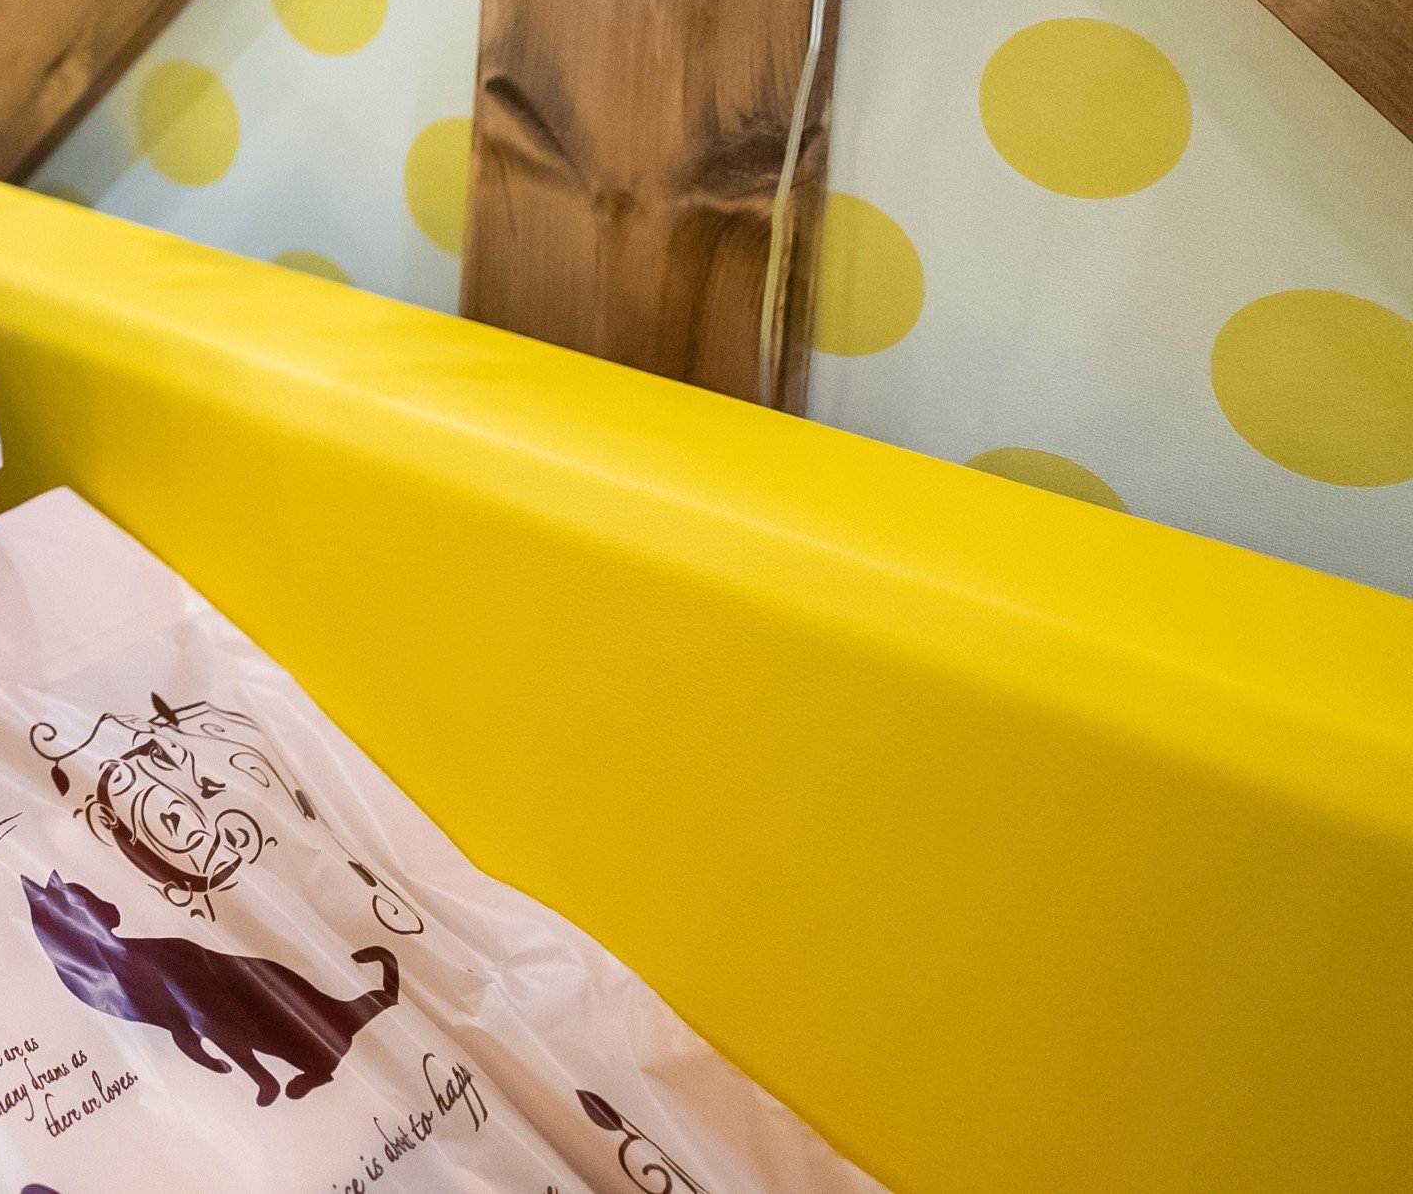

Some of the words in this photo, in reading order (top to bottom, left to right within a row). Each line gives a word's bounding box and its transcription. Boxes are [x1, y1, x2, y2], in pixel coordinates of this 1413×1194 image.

[2, 1044, 25, 1063] are
[24, 1037, 40, 1053] as
[23, 1057, 71, 1091] dreams
[71, 1049, 88, 1069] as
[91, 1070, 139, 1104] loves.
[44, 1093, 82, 1138] there
[81, 1096, 103, 1115] are
[360, 1155, 384, 1181] is
[408, 1113, 433, 1142] to
